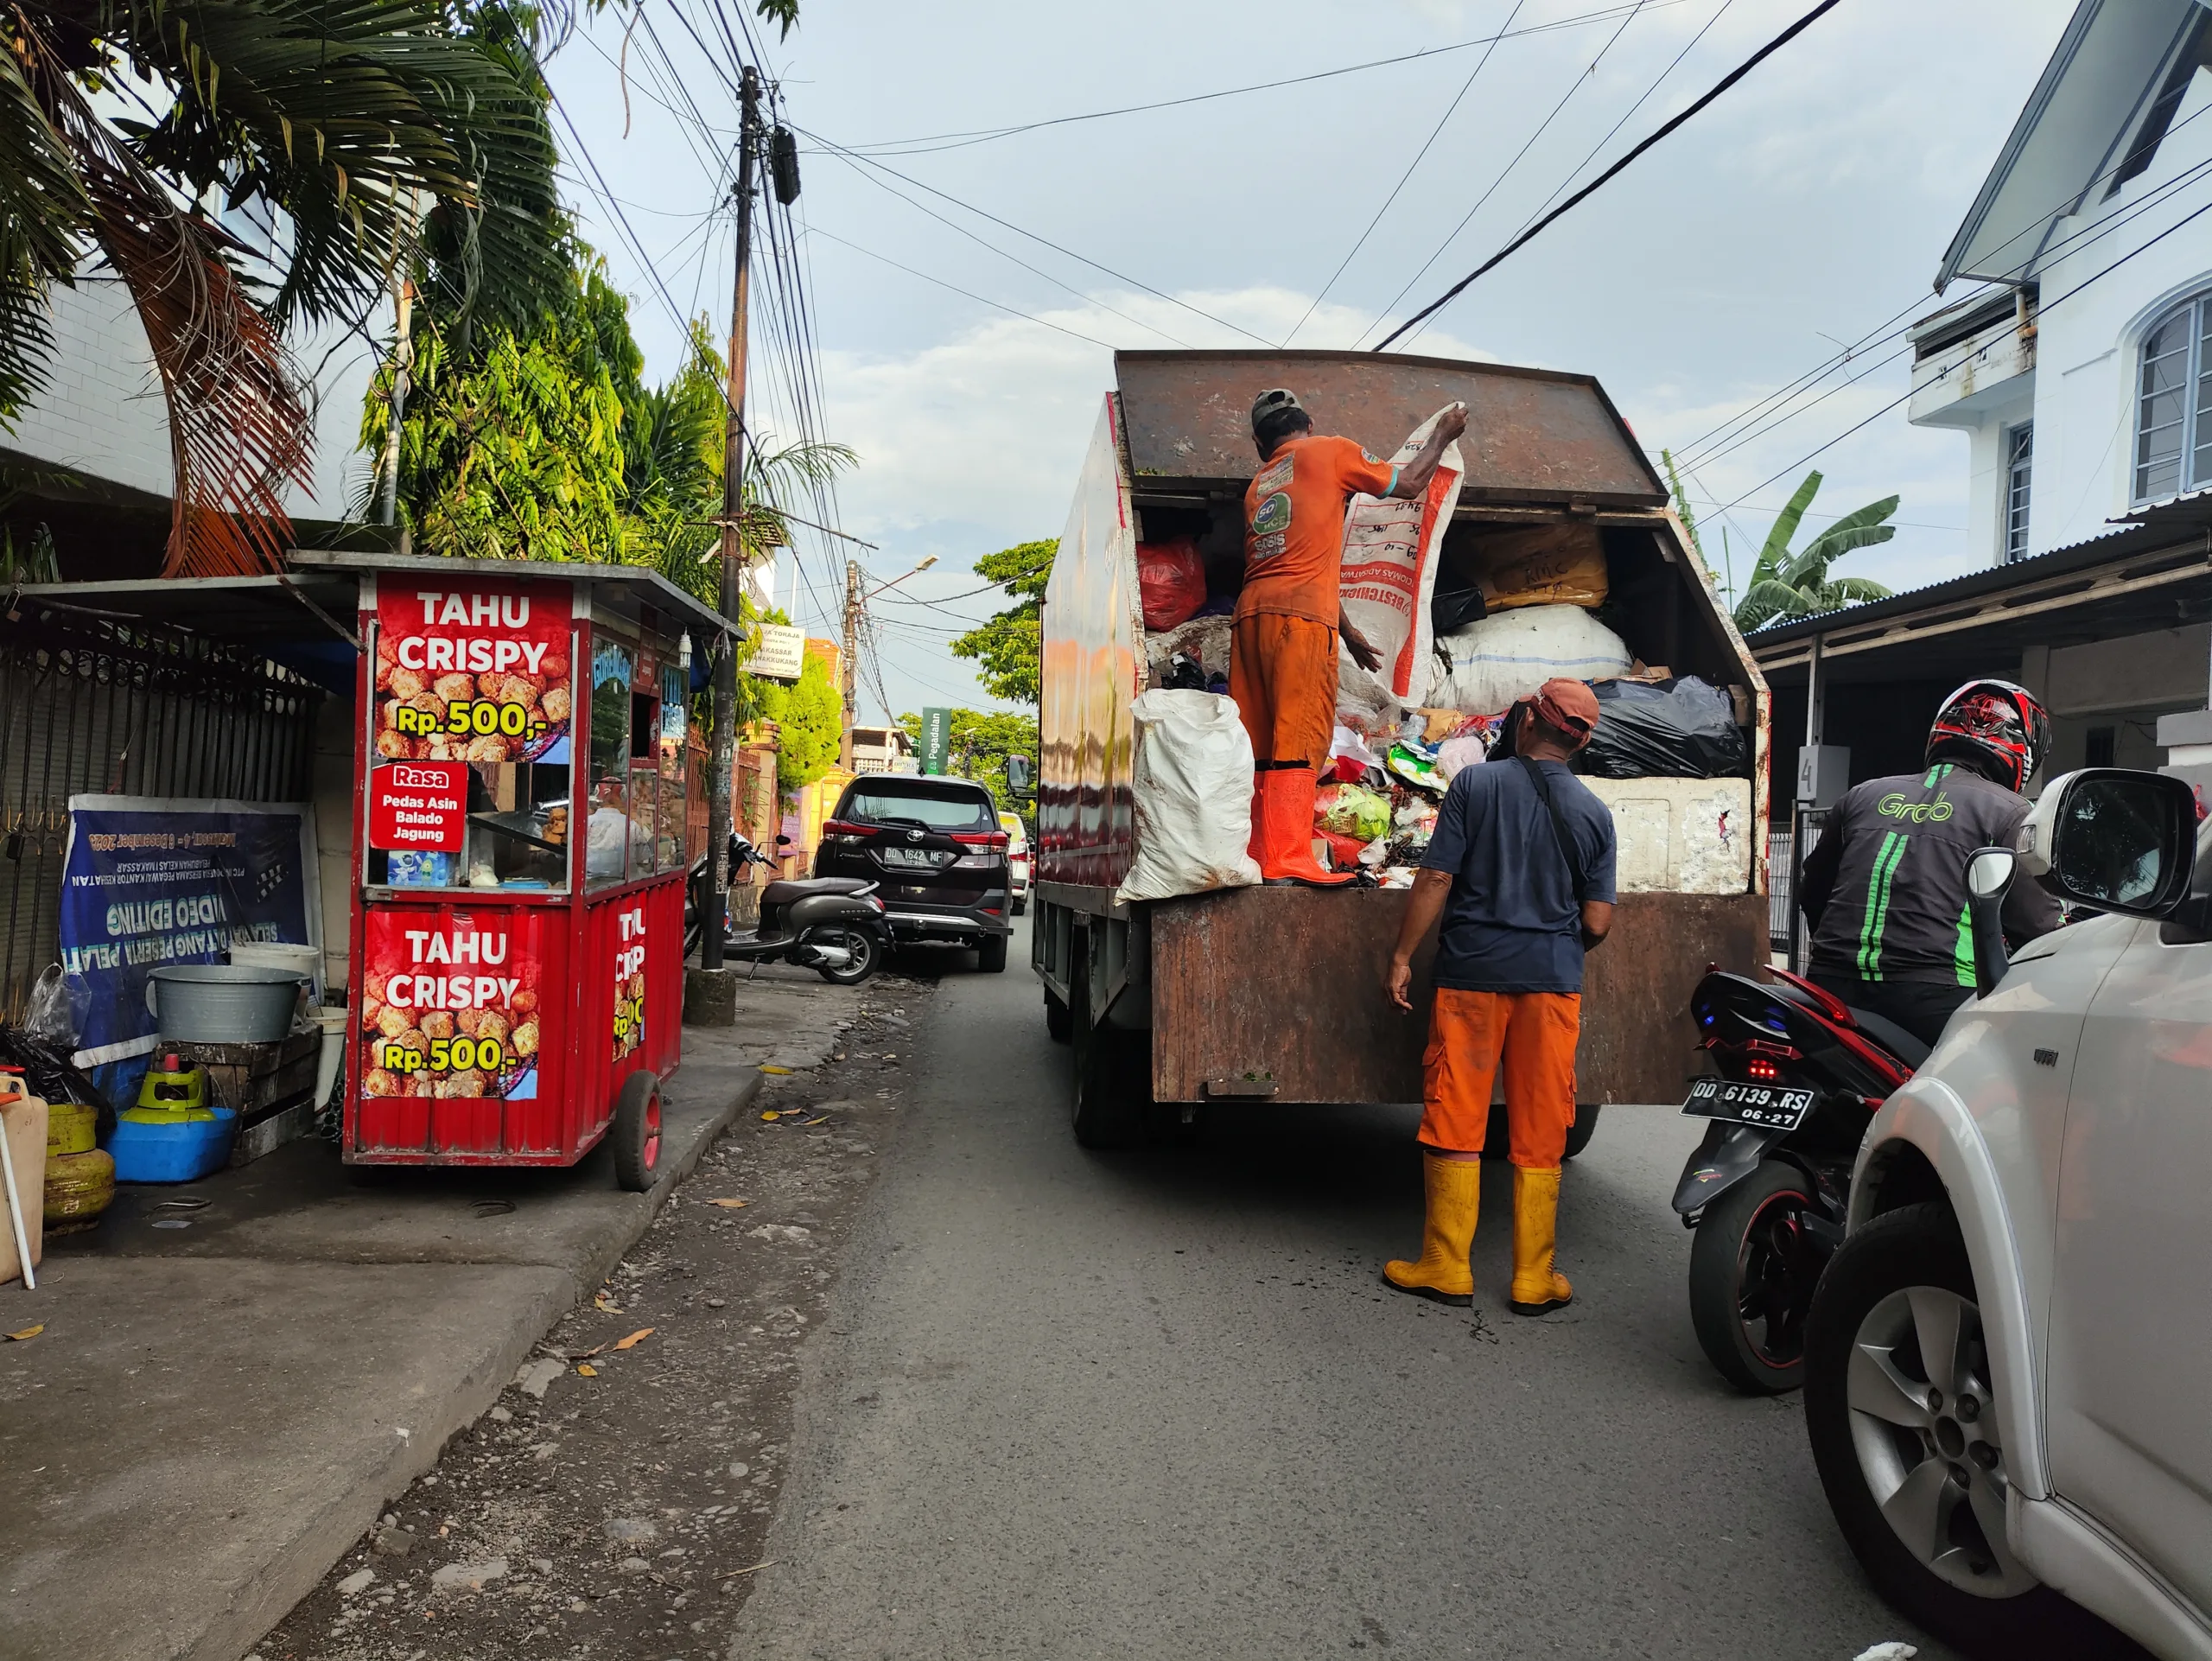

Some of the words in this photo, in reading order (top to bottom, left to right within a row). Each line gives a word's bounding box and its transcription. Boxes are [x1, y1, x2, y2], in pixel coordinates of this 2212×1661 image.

[1382, 570, 1413, 586] CIOMAS
[416, 591, 531, 629] TAHU
[773, 630, 800, 639] TORAJA
[397, 636, 550, 675] CRISPY
[753, 656, 798, 666] ANAKKUKANG
[761, 646, 792, 656] AKASSAR
[397, 701, 548, 741] Rp.500,-
[393, 766, 449, 788] Rasa
[1801, 758, 1812, 792] 4
[383, 794, 424, 808] Pedas
[427, 797, 458, 811] Asin
[1878, 792, 1955, 824] Grab
[396, 811, 444, 824] Balado
[393, 826, 444, 843] Jagung
[159, 861, 178, 871] KELAS
[886, 848, 897, 858] DD
[905, 849, 924, 861] 1642
[930, 851, 942, 862] MF
[118, 862, 156, 873] MAKASSAR
[118, 874, 145, 884] KANTOR
[106, 900, 173, 936] EDITING
[175, 894, 227, 926] VIDEO
[404, 930, 508, 965] TAHU
[386, 974, 521, 1010] CRISPY
[385, 1037, 518, 1077] Rp.500,-
[1693, 1082, 1717, 1098] DD
[1725, 1085, 1771, 1105] 6139
[1779, 1092, 1807, 1111] RS
